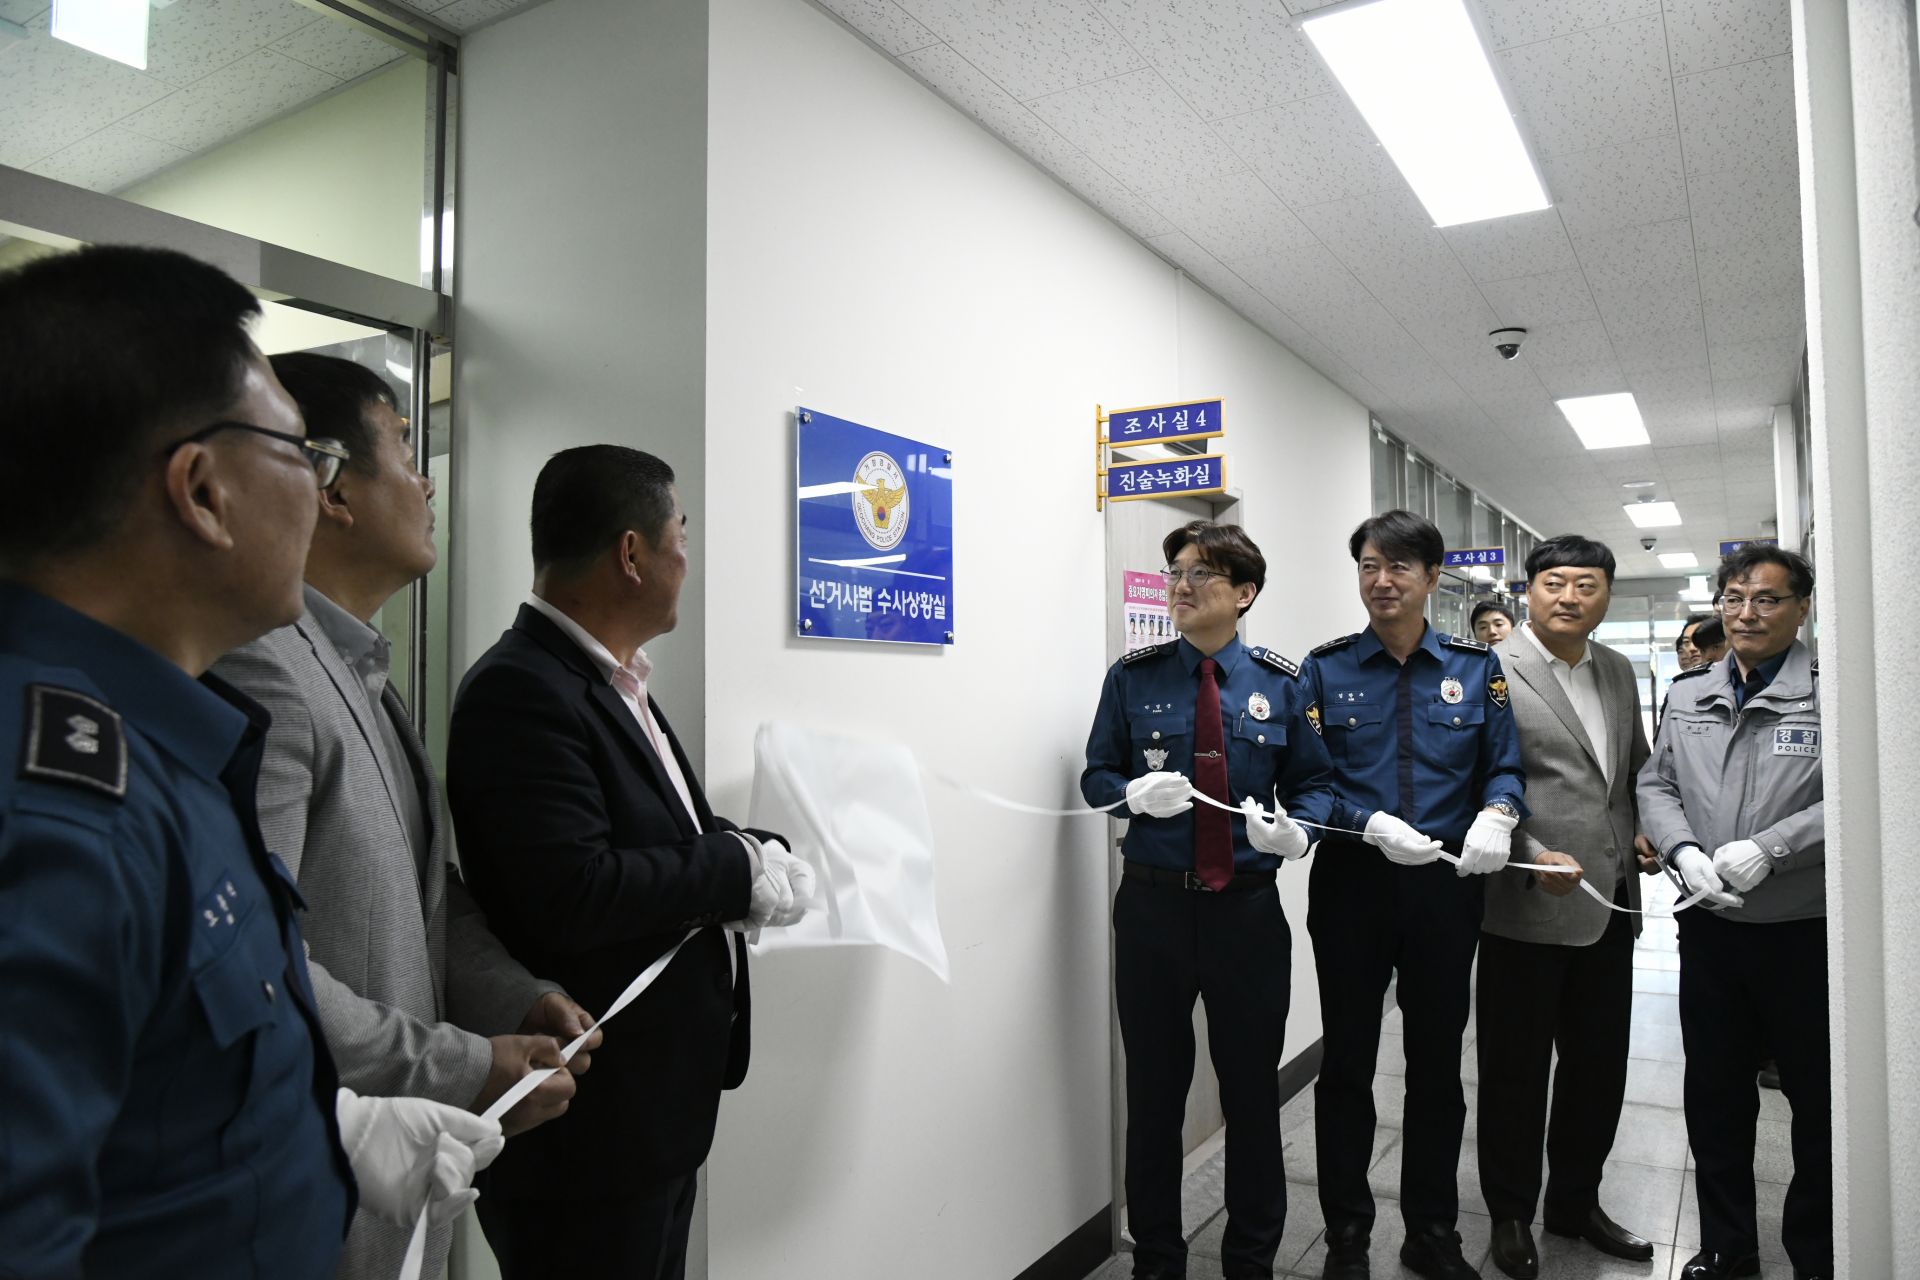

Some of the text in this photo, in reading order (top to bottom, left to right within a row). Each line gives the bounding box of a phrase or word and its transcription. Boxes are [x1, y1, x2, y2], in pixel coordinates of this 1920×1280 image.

[1119, 464, 1210, 492] 진술녹화실
[876, 533, 893, 544] POLICE
[893, 511, 905, 540] STATION
[809, 579, 946, 620] 선거사범 수사상황실
[1777, 745, 1816, 754] POLICE
